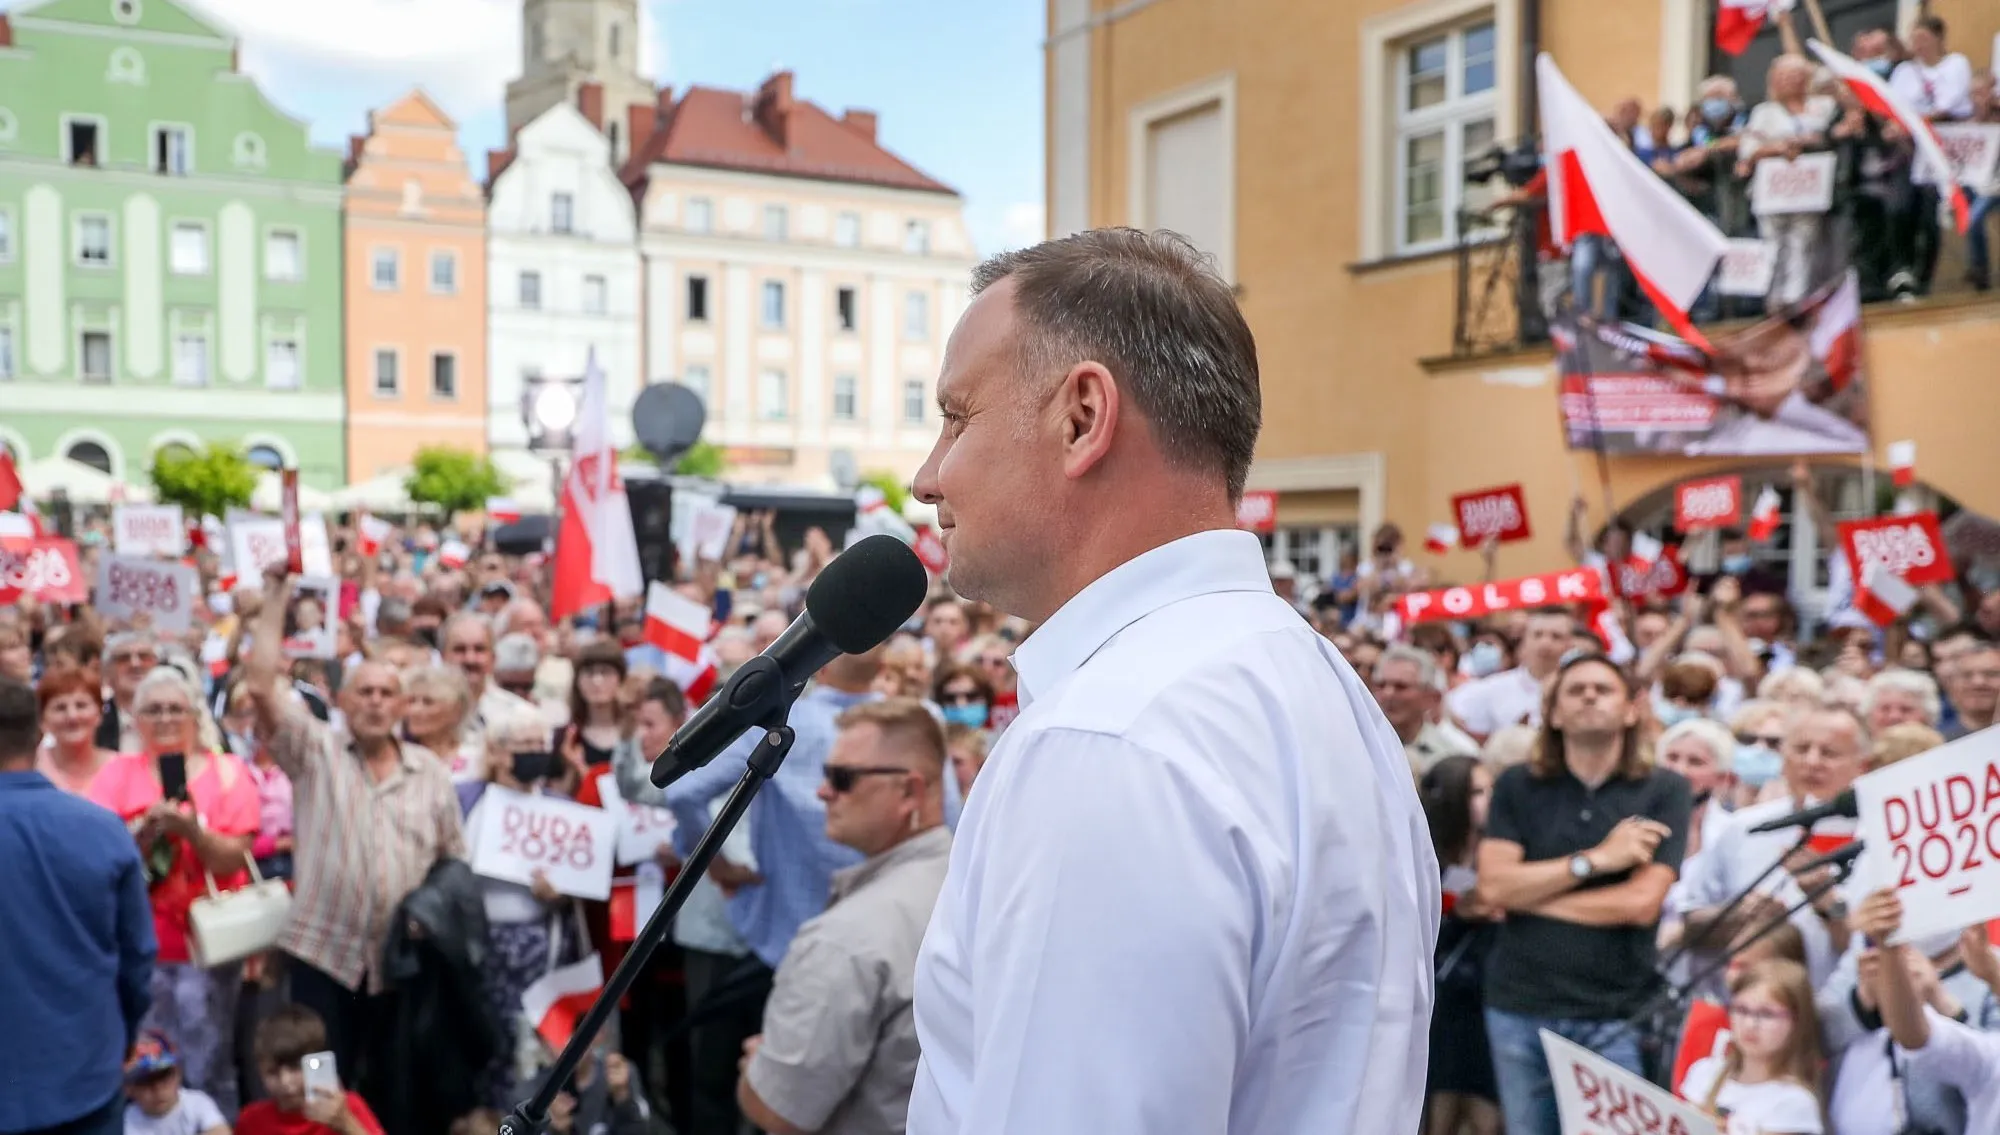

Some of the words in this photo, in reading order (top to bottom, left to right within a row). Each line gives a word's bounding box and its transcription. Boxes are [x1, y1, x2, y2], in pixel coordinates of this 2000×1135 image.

[1884, 762, 2000, 842] DUDA
[503, 804, 593, 844] DUDA
[501, 831, 594, 870] 2020
